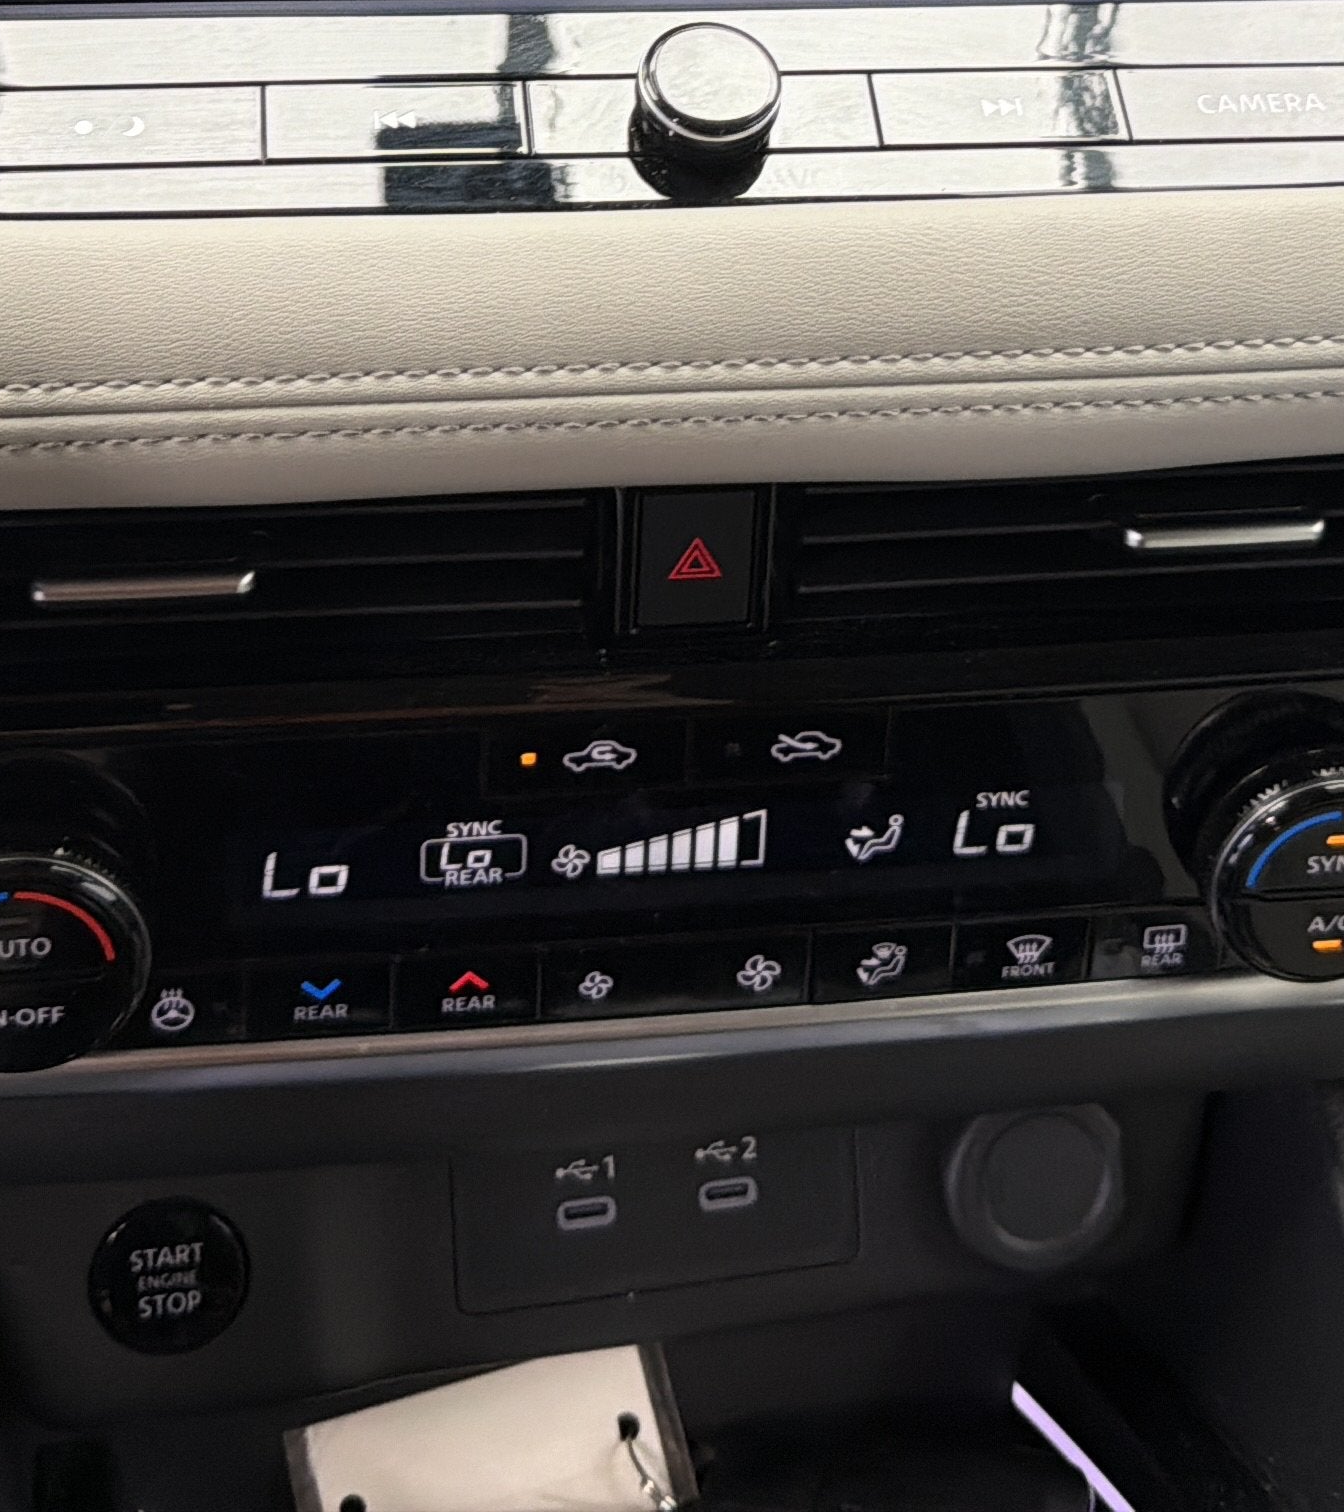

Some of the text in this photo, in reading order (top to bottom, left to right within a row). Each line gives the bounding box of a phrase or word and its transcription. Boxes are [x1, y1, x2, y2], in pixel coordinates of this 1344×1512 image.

[1196, 92, 1328, 115] CAMERA
[976, 790, 1030, 810] SYNC
[446, 819, 504, 838] SYNC
[953, 810, 1036, 857] Lo
[439, 842, 493, 871] Lo
[263, 851, 350, 900] Lo
[444, 867, 504, 888] REAR
[1002, 960, 1055, 980] FRONT
[1141, 951, 1183, 969] REAR
[293, 1002, 349, 1022] REAR
[441, 994, 496, 1014] REAR
[740, 1136, 758, 1160] 2
[602, 1155, 617, 1179] 1
[129, 1241, 205, 1273] START
[137, 1269, 198, 1292] ENGINE
[138, 1289, 202, 1319] STOP
